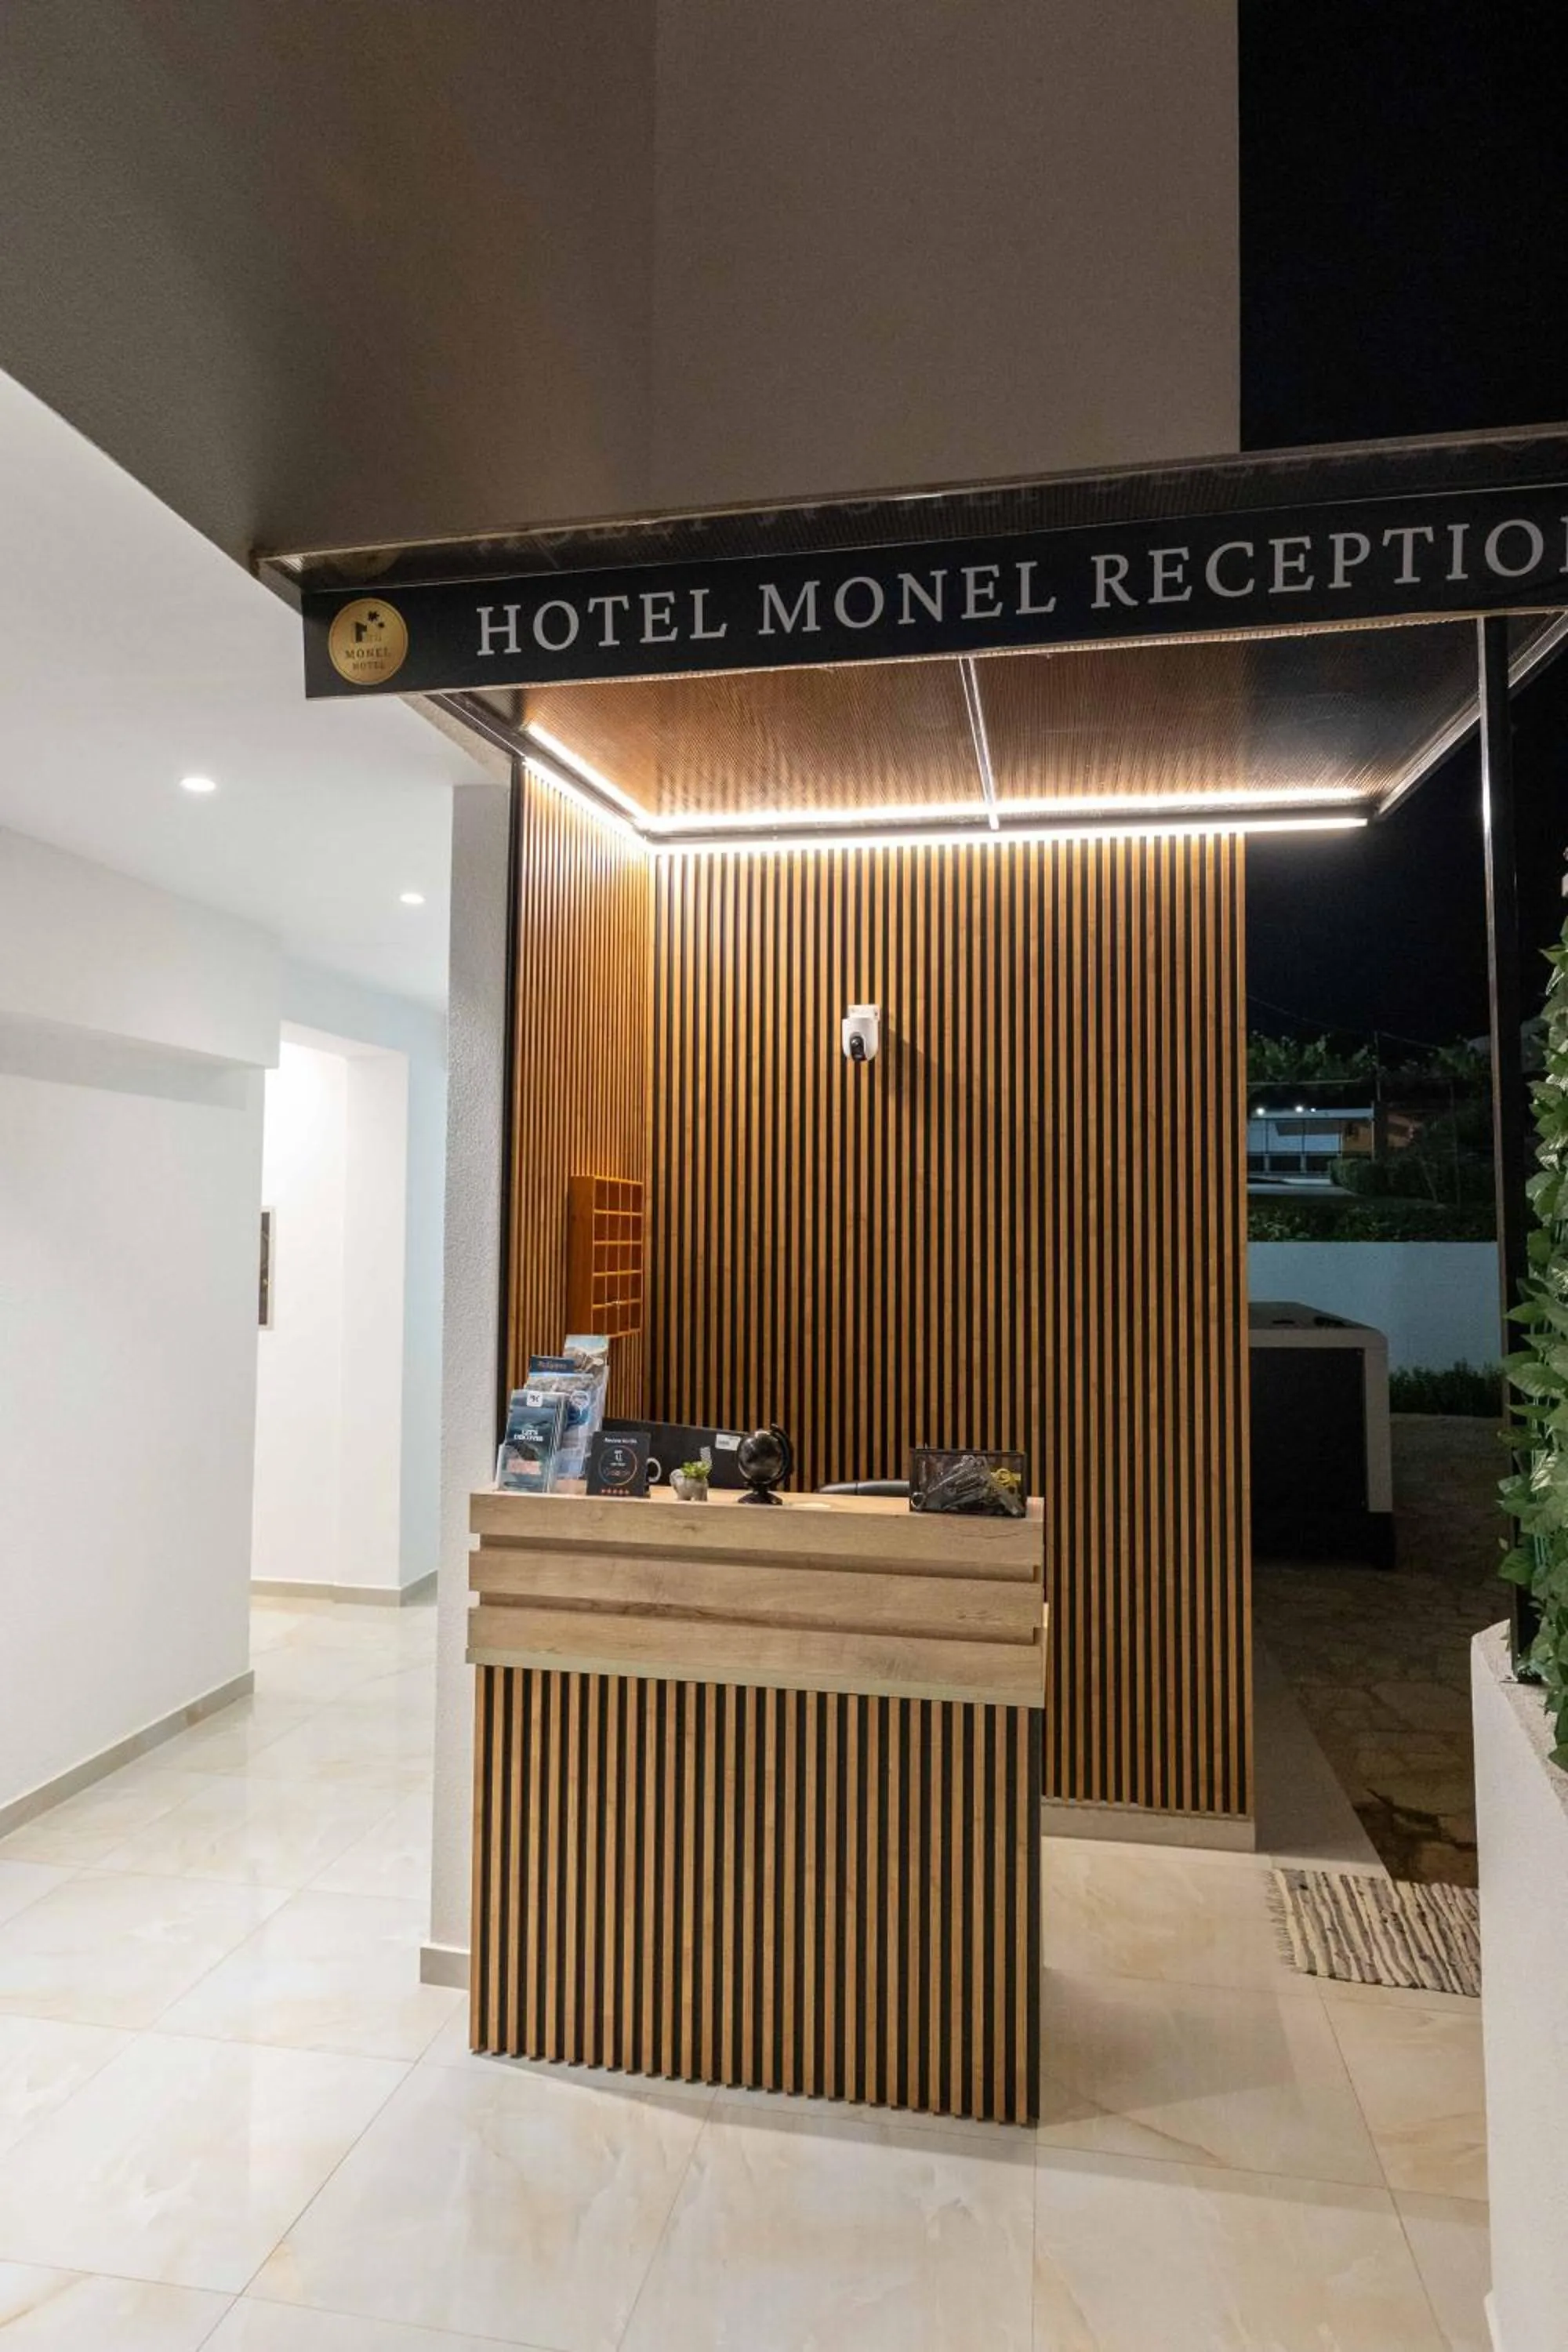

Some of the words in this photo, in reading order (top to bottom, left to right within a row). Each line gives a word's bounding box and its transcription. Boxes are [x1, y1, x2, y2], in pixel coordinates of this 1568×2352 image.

[476, 589, 728, 656] HOTEL
[757, 561, 1056, 635] MONEL
[1091, 517, 1568, 609] RECEPTIO
[345, 647, 390, 659] MONEL
